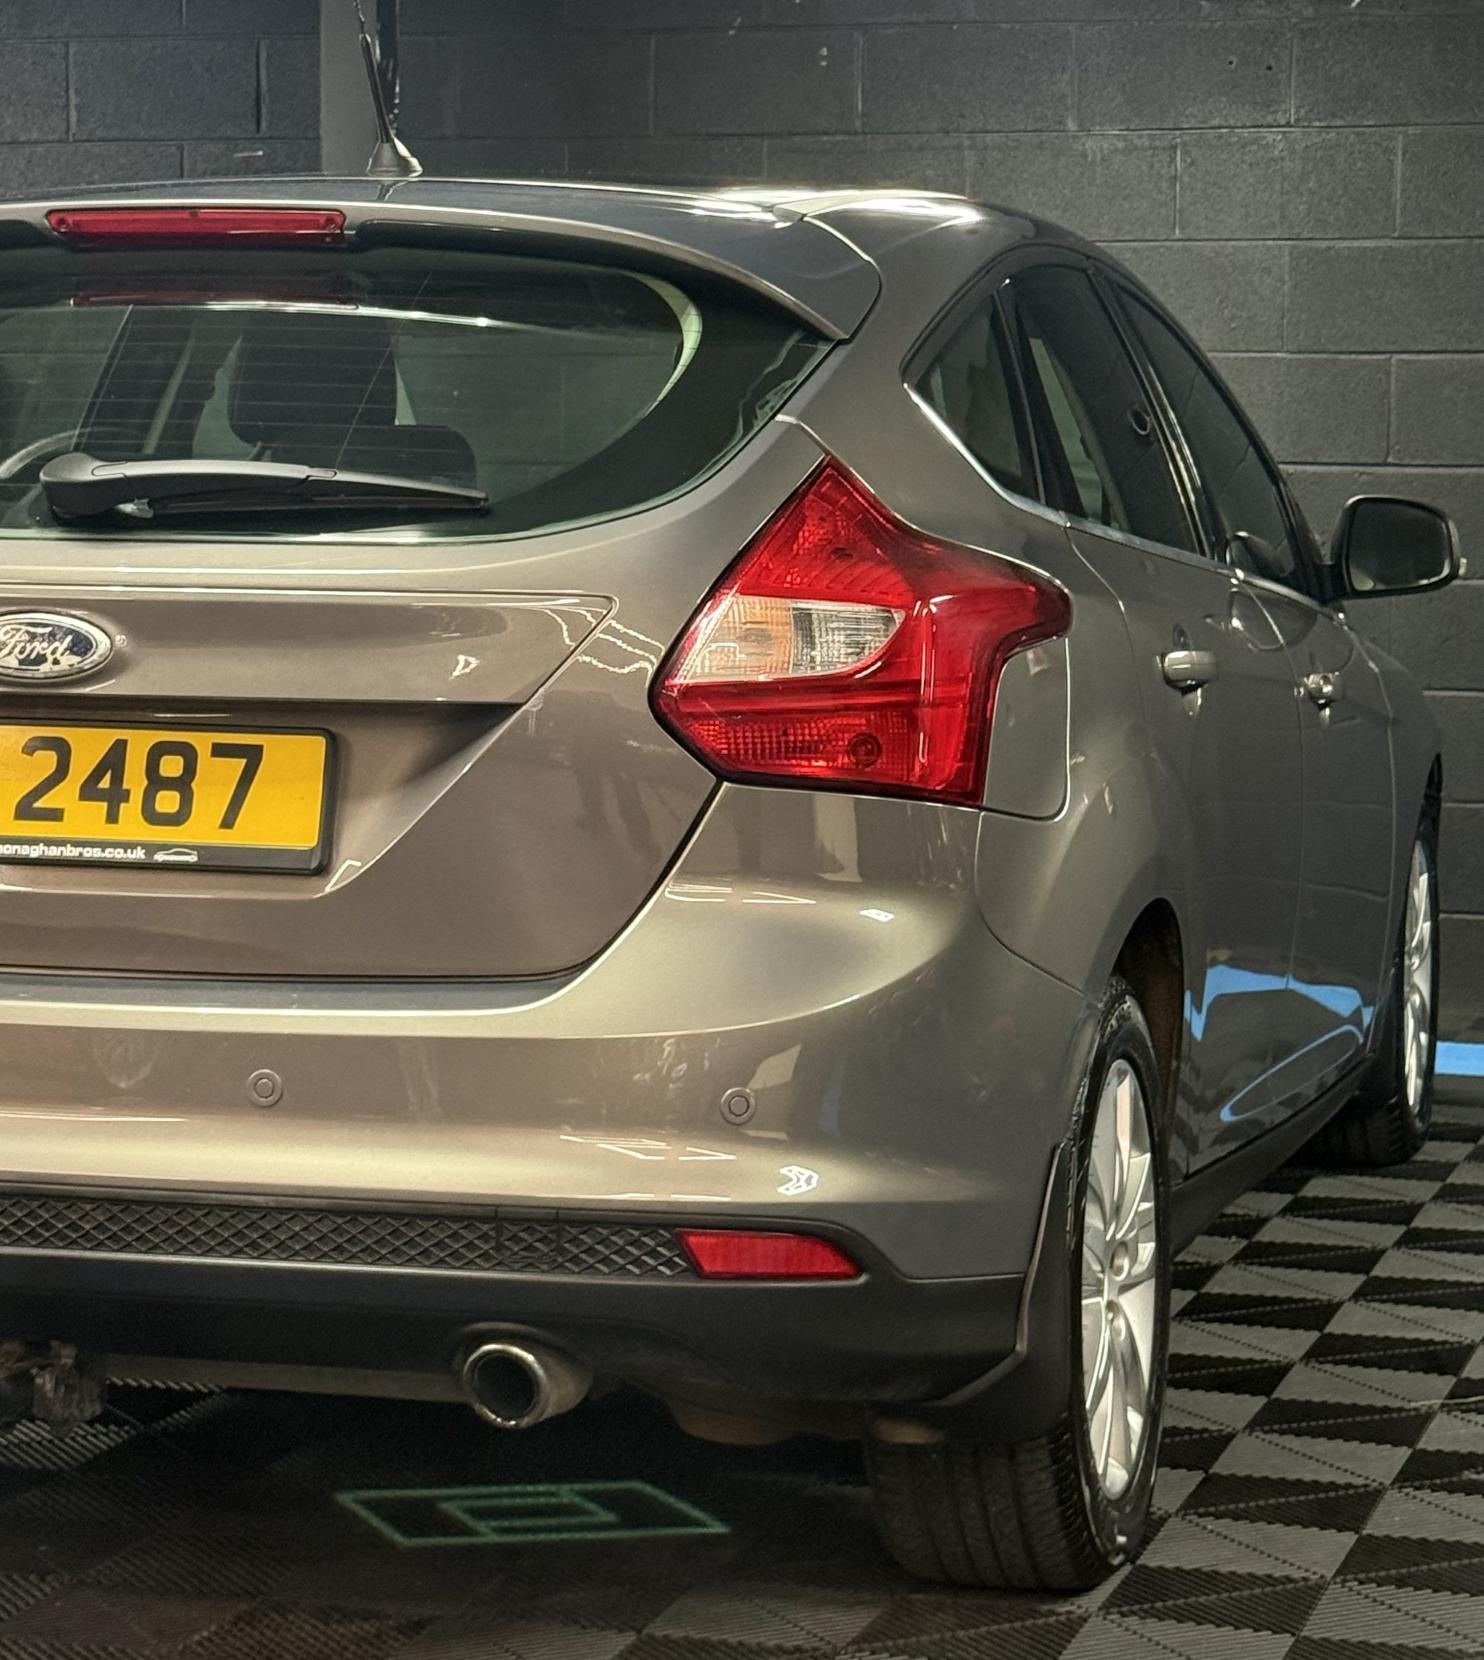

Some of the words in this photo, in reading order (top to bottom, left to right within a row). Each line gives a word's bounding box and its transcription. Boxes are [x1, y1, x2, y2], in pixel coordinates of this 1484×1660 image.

[0, 625, 73, 660] Ford
[13, 735, 264, 830] 2487
[0, 843, 146, 860] onaghanbros.co.uk
